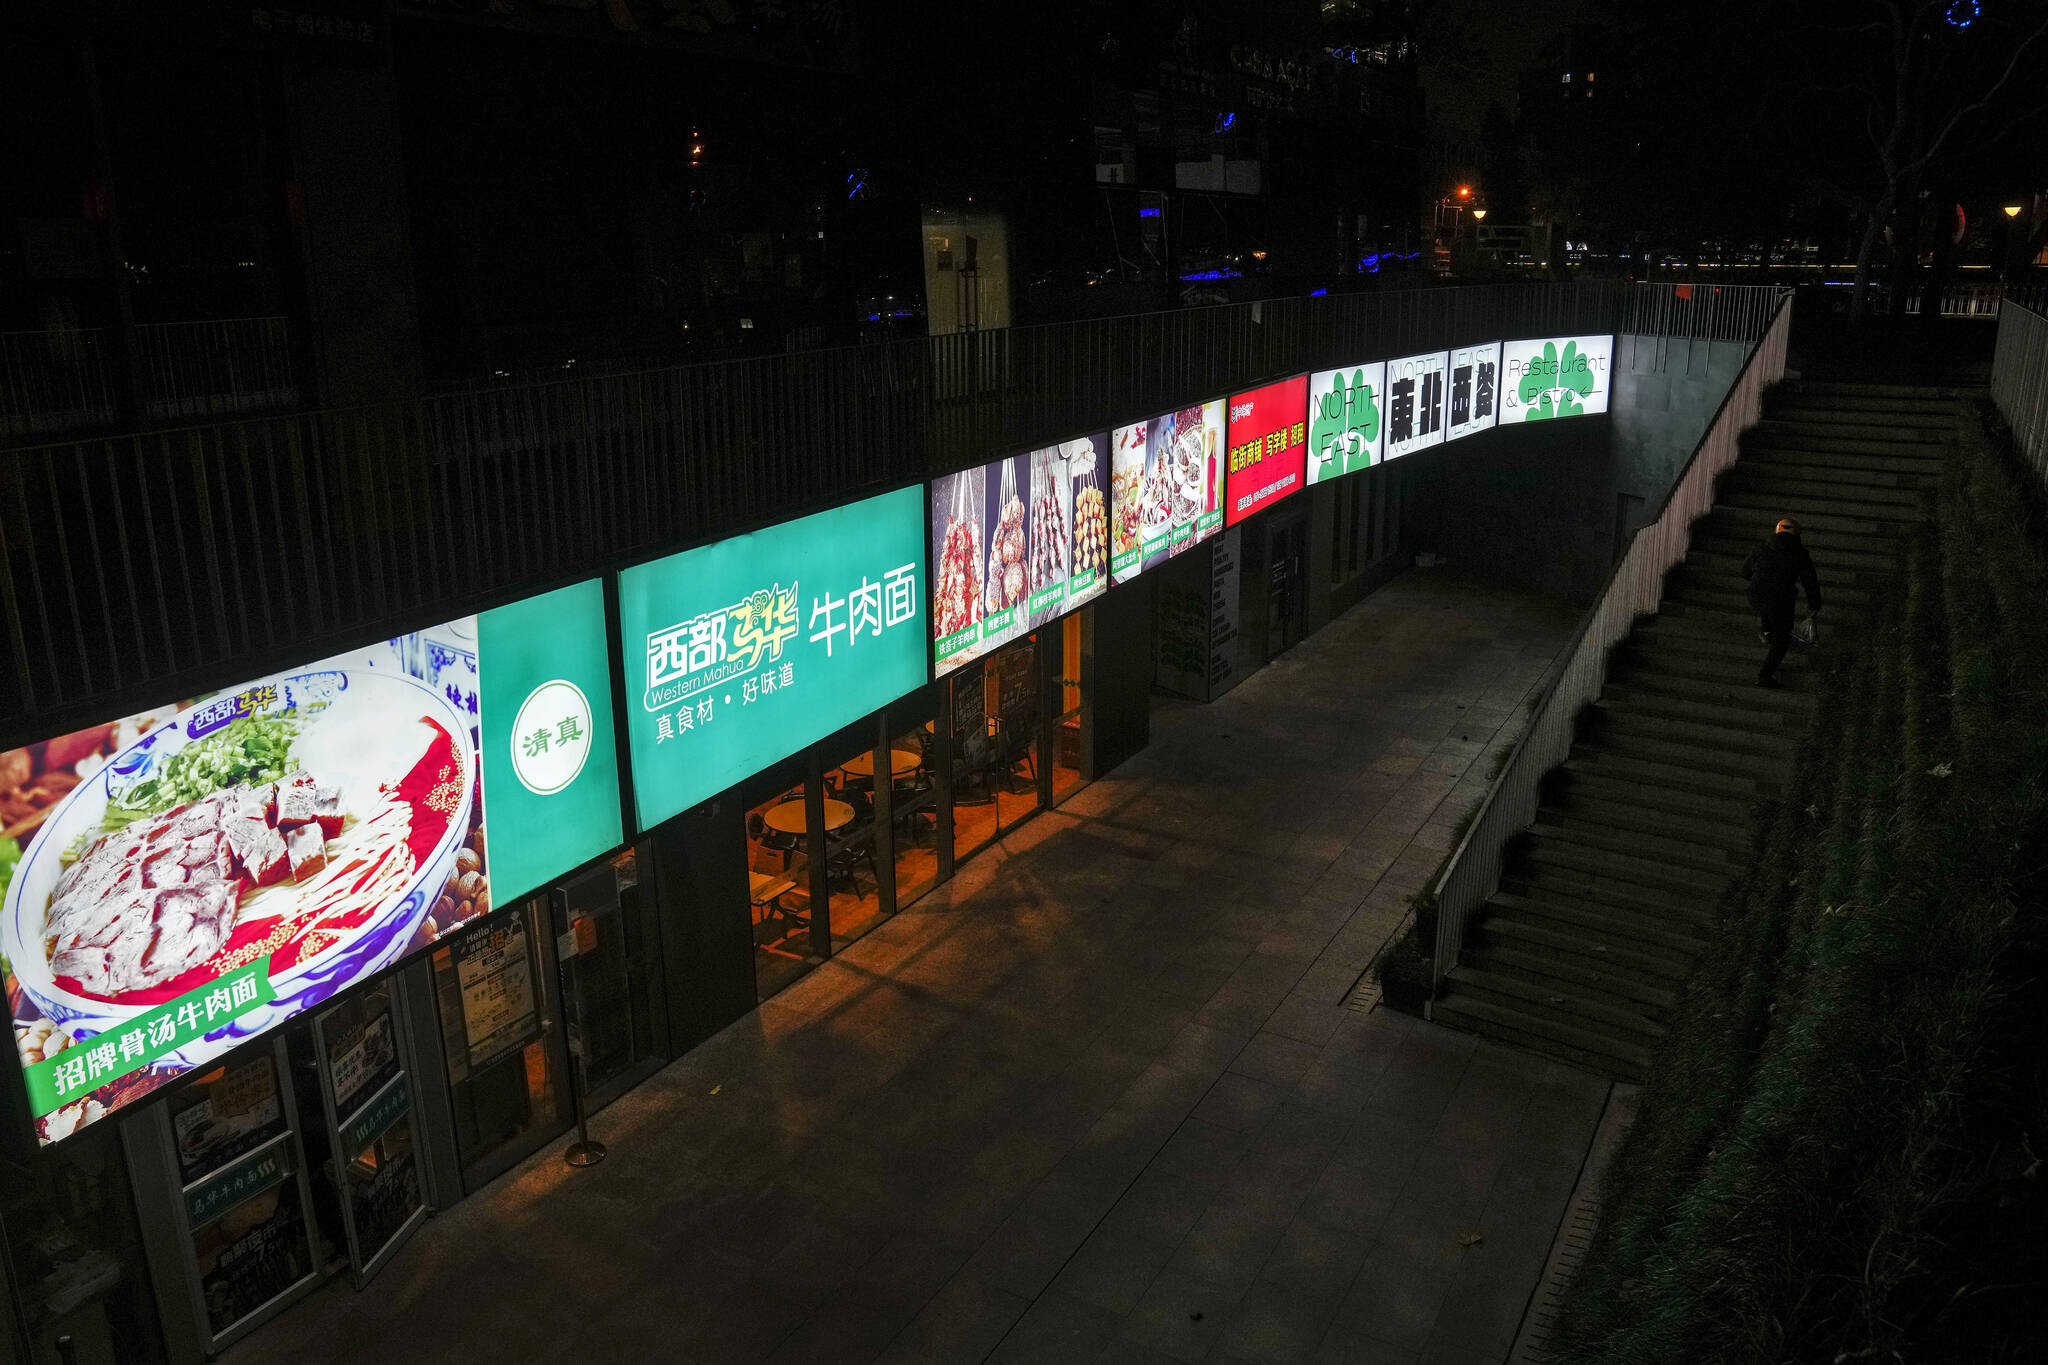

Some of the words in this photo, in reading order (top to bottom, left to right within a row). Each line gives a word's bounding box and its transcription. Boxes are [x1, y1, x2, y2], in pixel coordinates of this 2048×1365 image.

[1509, 354, 1606, 377] Restaurant
[1313, 381, 1380, 423] NORTH
[1506, 390, 1518, 407] &
[1527, 386, 1575, 406] Bistro
[1230, 436, 1263, 475] 临街商铺
[1266, 426, 1288, 458] 写字楼
[1320, 423, 1371, 463] EAST
[808, 562, 916, 657] 牛肉面
[939, 628, 976, 656] 铁签子羊肉串
[651, 676, 702, 706] Western
[703, 658, 744, 686] Mahua
[655, 695, 714, 745] 真食材
[742, 661, 794, 706] 好味道
[522, 714, 584, 757] 清真
[466, 923, 494, 945] Hello!
[52, 971, 258, 1097] 招牌骨汤牛肉面
[193, 1170, 258, 1215] 马华牛肉面
